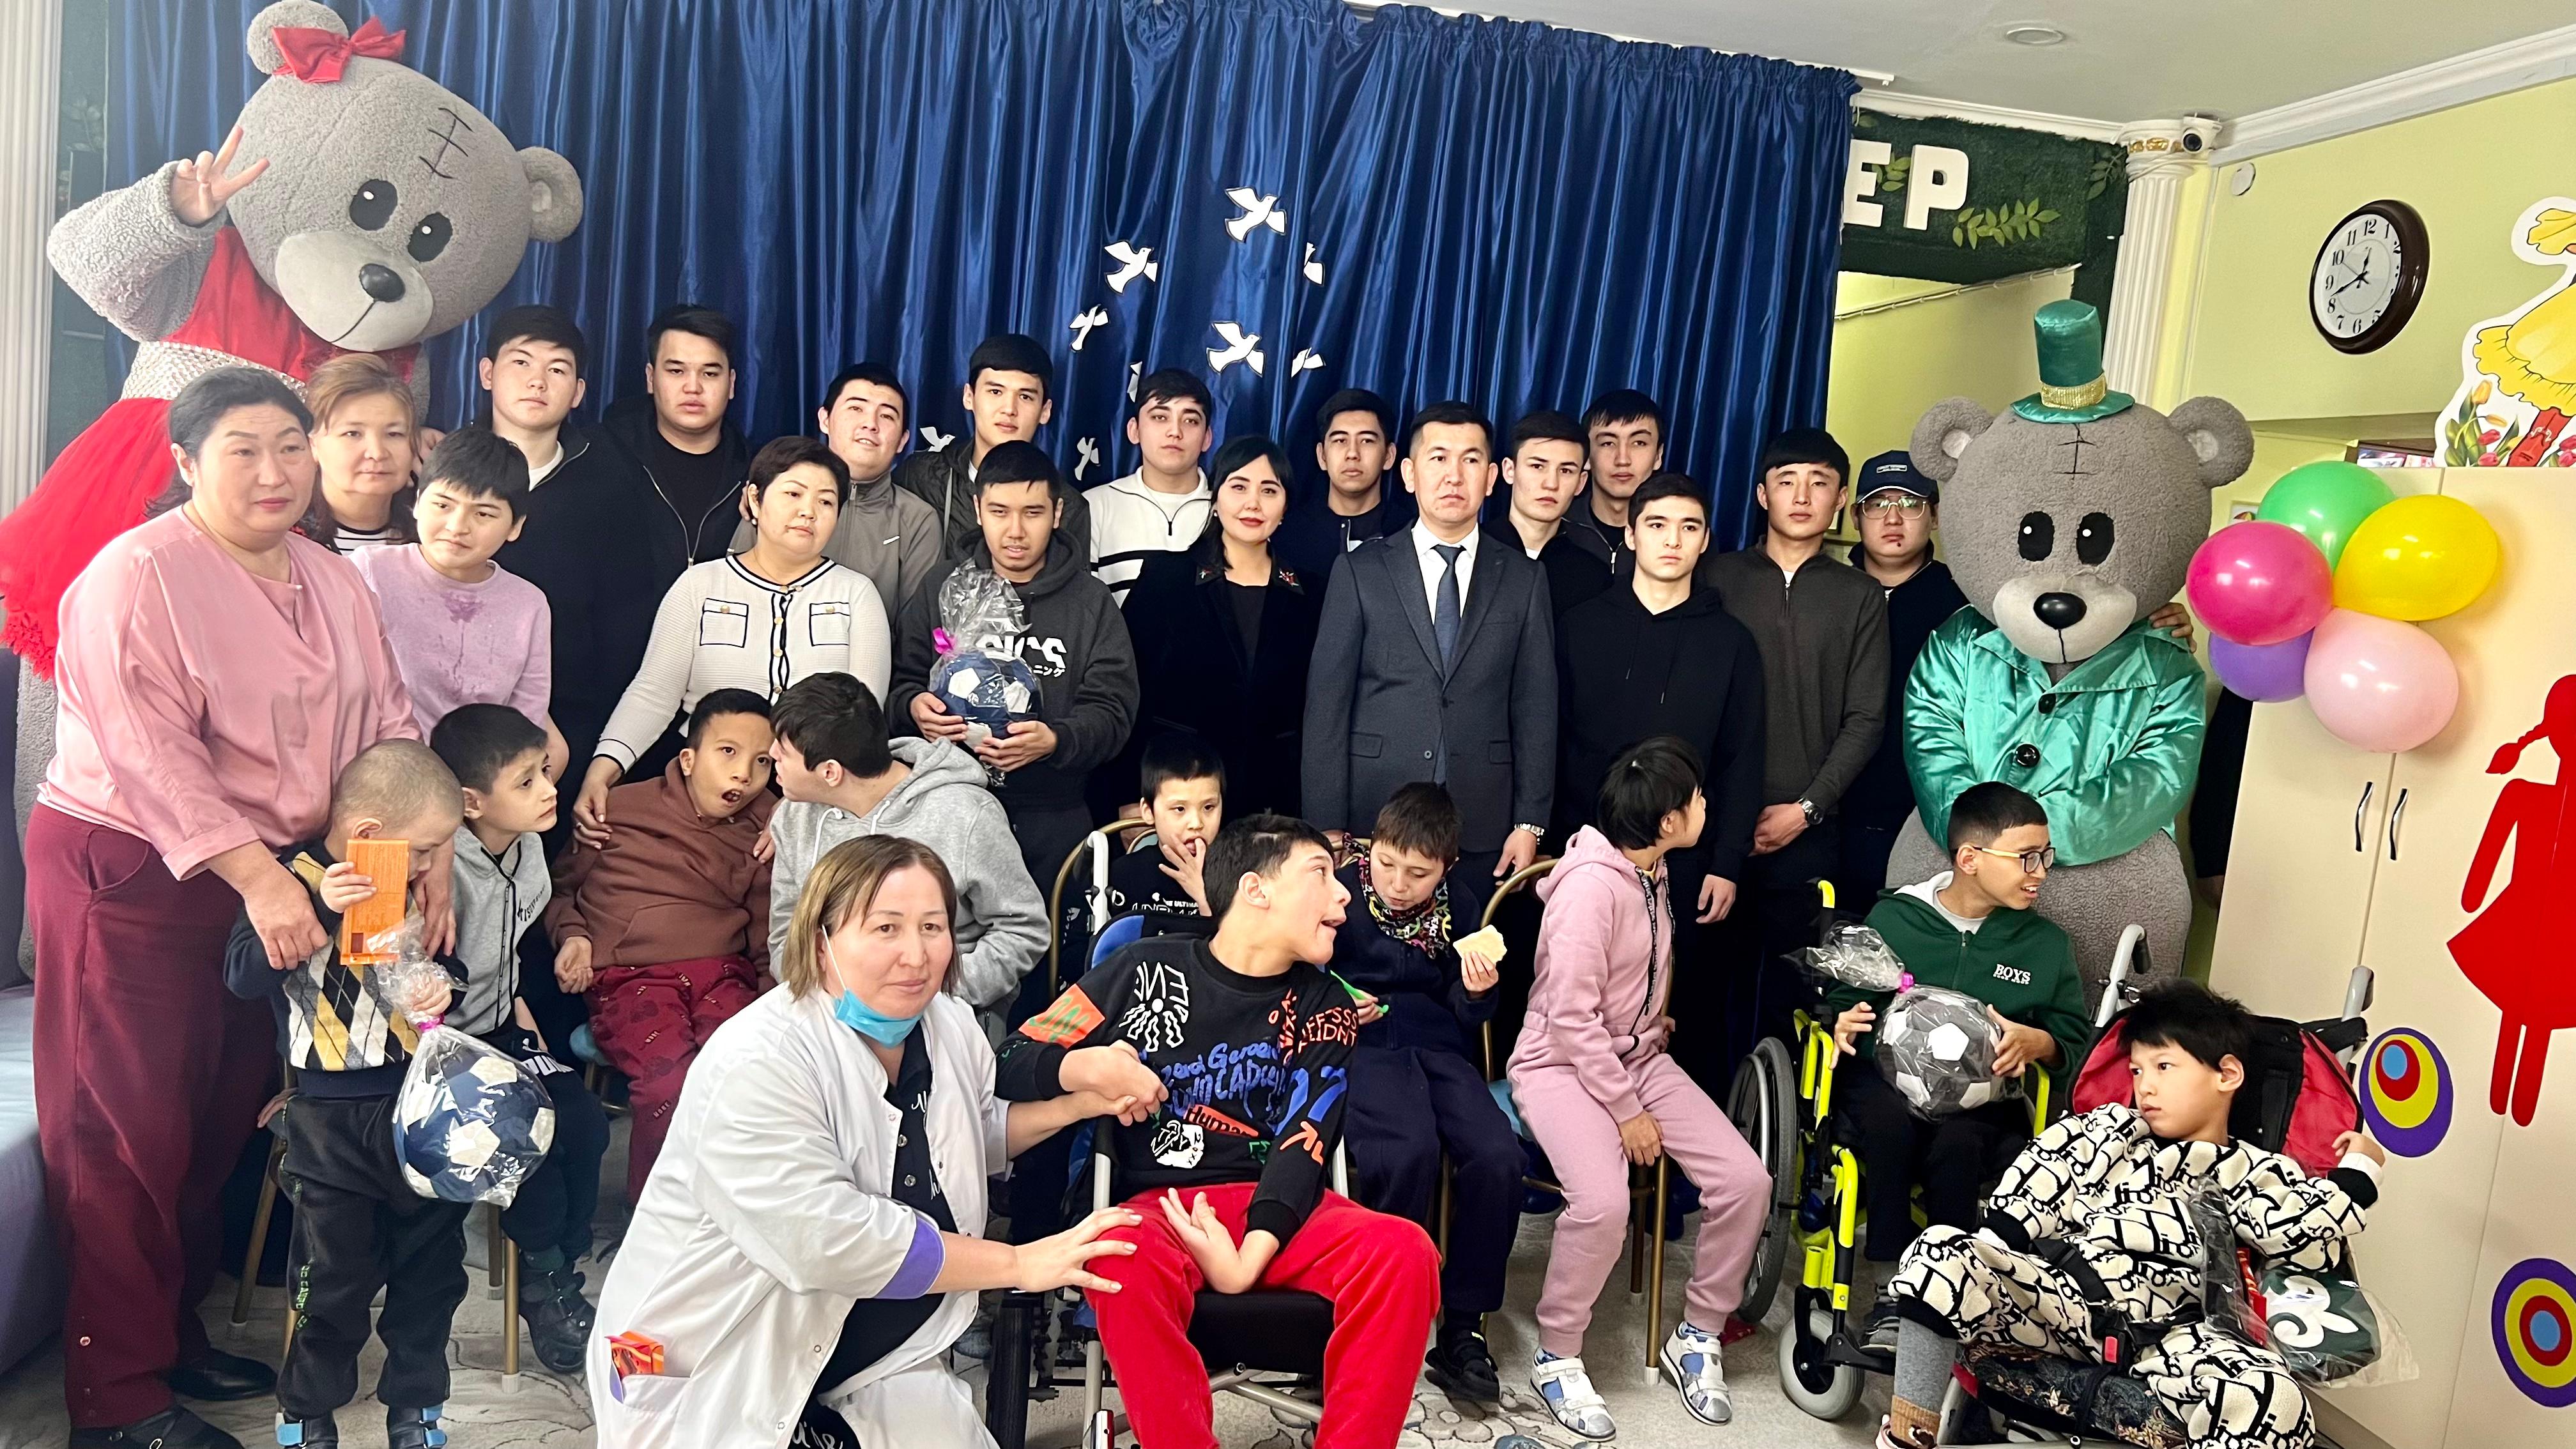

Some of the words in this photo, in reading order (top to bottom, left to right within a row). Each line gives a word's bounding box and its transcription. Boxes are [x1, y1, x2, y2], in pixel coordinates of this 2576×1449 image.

[2363, 218, 2377, 236] 12
[2346, 229, 2358, 246] 11
[2331, 249, 2345, 266] 10
[2325, 275, 2334, 290] 9
[2327, 298, 2336, 314] 8
[2336, 314, 2345, 330] 7
[2352, 319, 2362, 334] 6
[1994, 963, 2031, 983] BOYS
